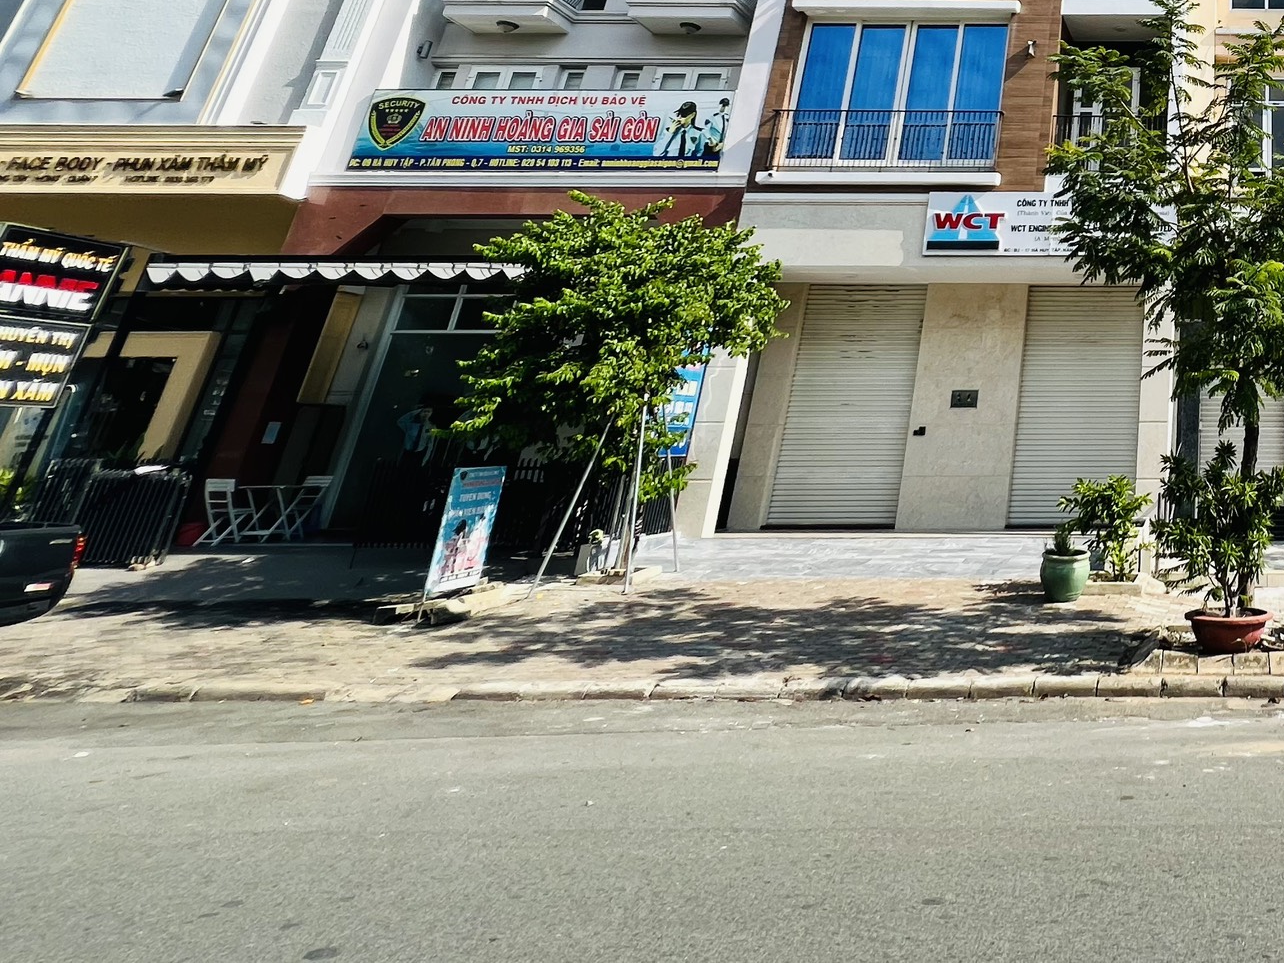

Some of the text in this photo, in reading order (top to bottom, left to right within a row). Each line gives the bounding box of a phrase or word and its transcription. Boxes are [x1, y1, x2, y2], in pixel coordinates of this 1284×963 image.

[378, 99, 421, 110] SECURITY
[452, 94, 487, 105] CÔNG
[491, 96, 507, 105] TY
[511, 96, 544, 105] TNHH
[582, 96, 598, 107] VỤ
[632, 95, 647, 107] VỆ
[420, 116, 449, 142] AN
[449, 116, 494, 142] NINH
[557, 116, 587, 142] GIA
[507, 145, 529, 154] MST:
[531, 145, 551, 154] 0314
[6, 156, 53, 171] FACE
[54, 156, 105, 171] BODY
[112, 157, 155, 171] PHUN
[400, 157, 414, 168] TẬP
[470, 158, 484, 168] Q.7
[578, 158, 600, 167] Email:
[1017, 198, 1036, 207] CÔNG
[933, 212, 1006, 230] WCT
[1011, 224, 1027, 232] WCT
[61, 250, 97, 270] QUỐC
[95, 254, 119, 272] TẾ
[25, 352, 73, 376] MỤN
